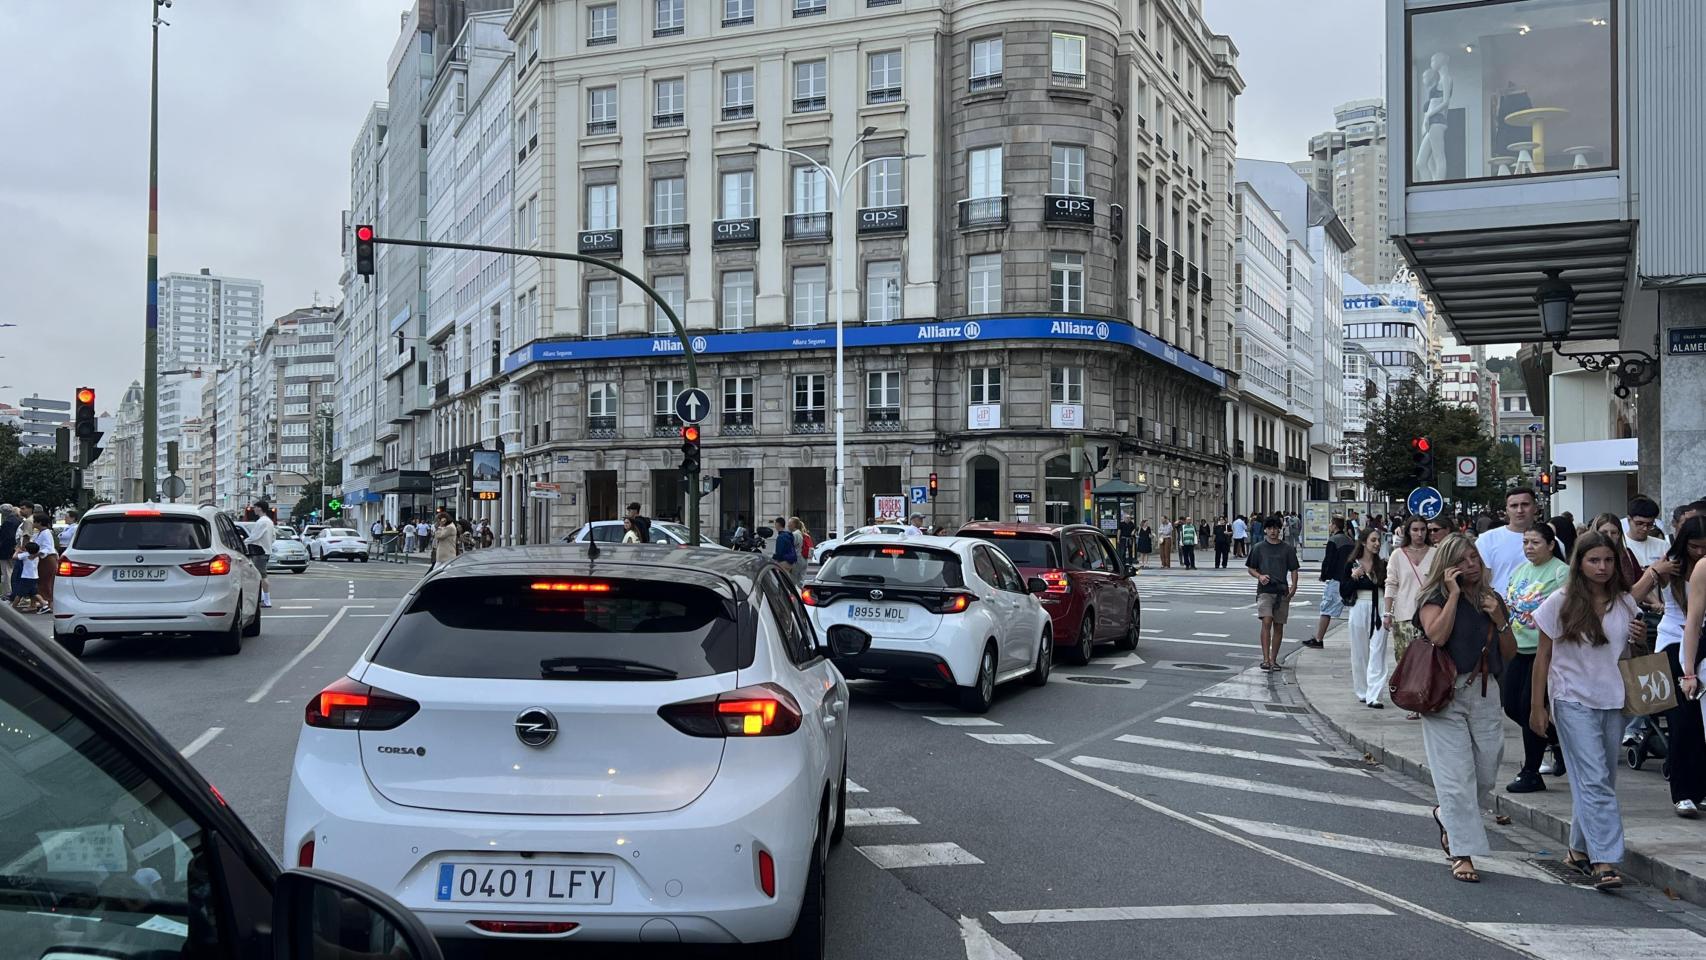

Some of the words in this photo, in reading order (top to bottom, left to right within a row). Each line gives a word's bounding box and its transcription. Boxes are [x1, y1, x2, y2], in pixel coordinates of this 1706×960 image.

[1055, 199, 1090, 212] aps
[863, 210, 898, 224] aps
[718, 222, 750, 235] aps
[583, 233, 613, 246] aps
[918, 326, 961, 339] Allianz
[1051, 321, 1094, 336] Allianz
[652, 339, 685, 352] Allian
[807, 338, 826, 346] Seguros
[913, 489, 923, 500] P
[878, 498, 901, 511] BURGERS
[880, 510, 901, 518] KFC
[119, 569, 144, 579] 8109
[146, 569, 166, 579] KJP
[854, 606, 881, 618] 8955
[884, 608, 905, 619] MDL
[377, 746, 416, 755] CORSA
[459, 868, 534, 898] 0401
[548, 869, 606, 899] LFY
